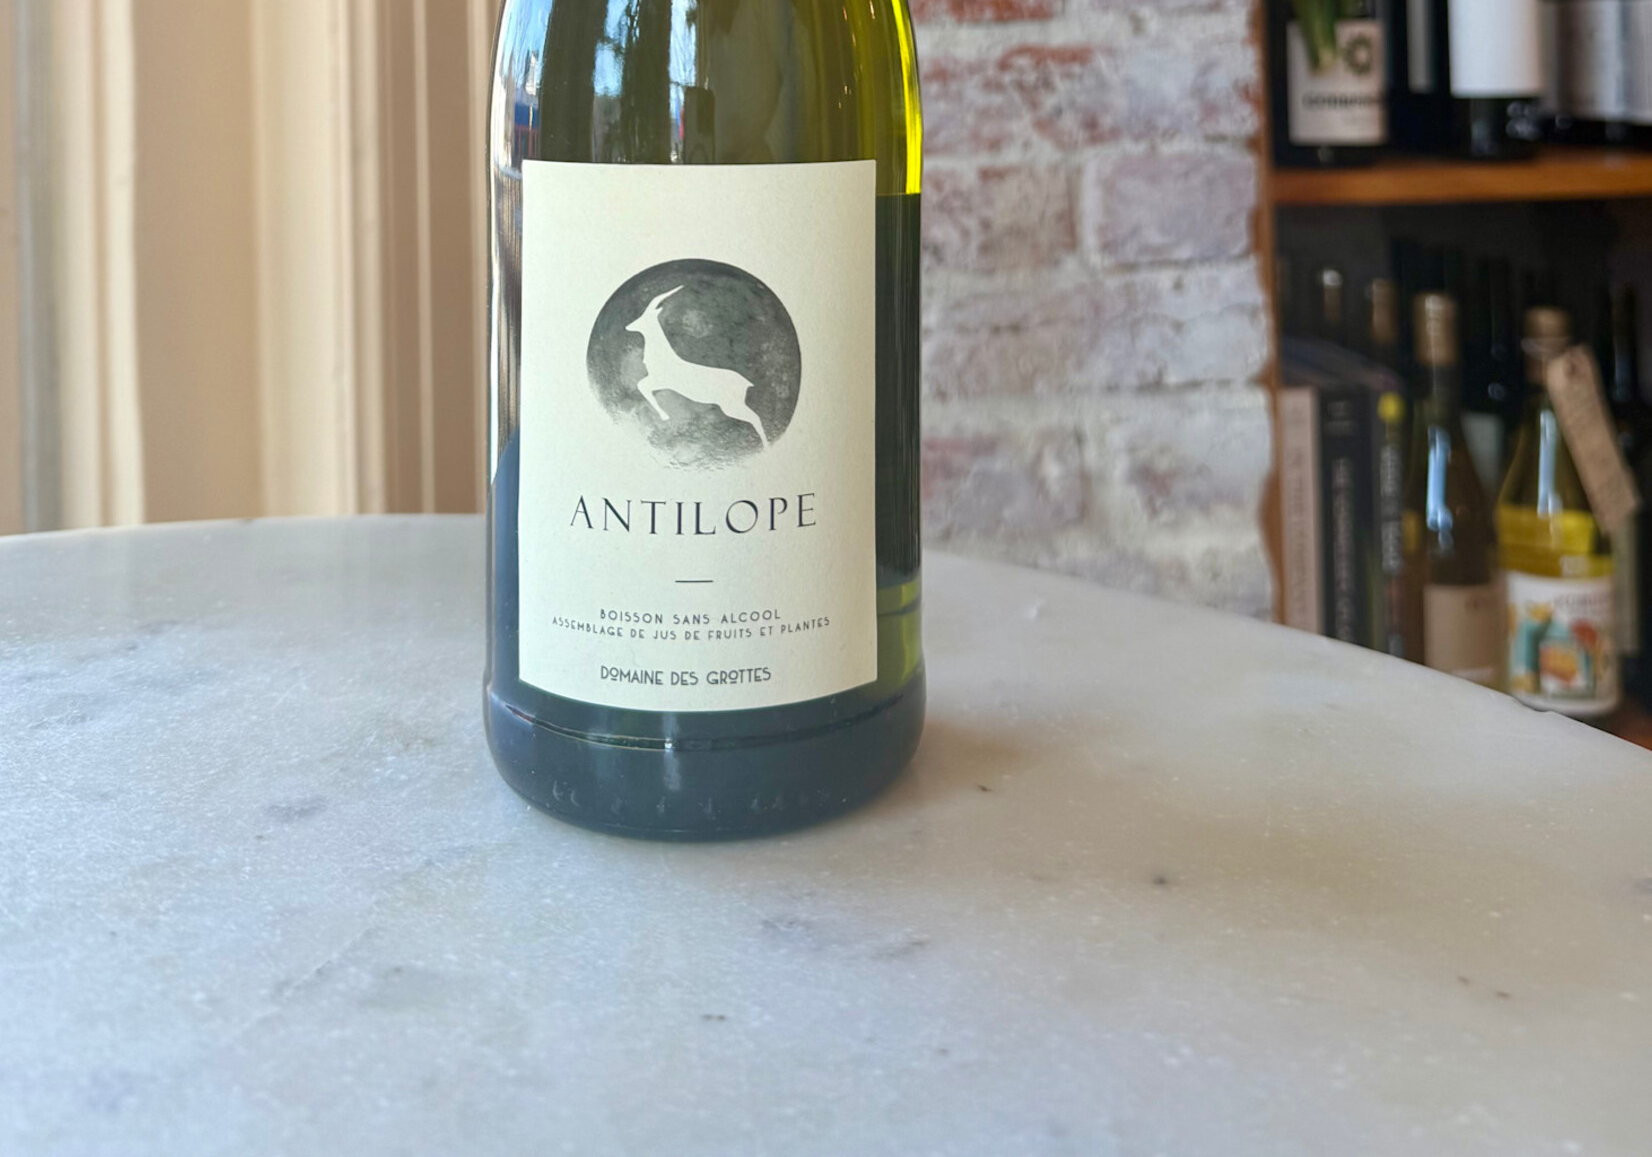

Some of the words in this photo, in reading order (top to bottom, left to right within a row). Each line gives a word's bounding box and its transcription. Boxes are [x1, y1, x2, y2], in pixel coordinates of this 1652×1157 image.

[569, 492, 817, 536] ANTILOPE
[600, 608, 663, 624] BOISSON
[672, 613, 710, 625] SANS
[720, 608, 781, 624] ALCOOL
[552, 616, 623, 637] ASSEMBLAGE
[630, 628, 645, 639] DE
[653, 630, 677, 641] JUS
[685, 630, 700, 641] DE
[708, 628, 752, 641] FRUITS
[760, 625, 774, 637] ET
[780, 616, 831, 634] PLANTES
[600, 665, 664, 686] DOMAINE
[670, 671, 699, 686] DES
[706, 666, 772, 686] GROTTES
